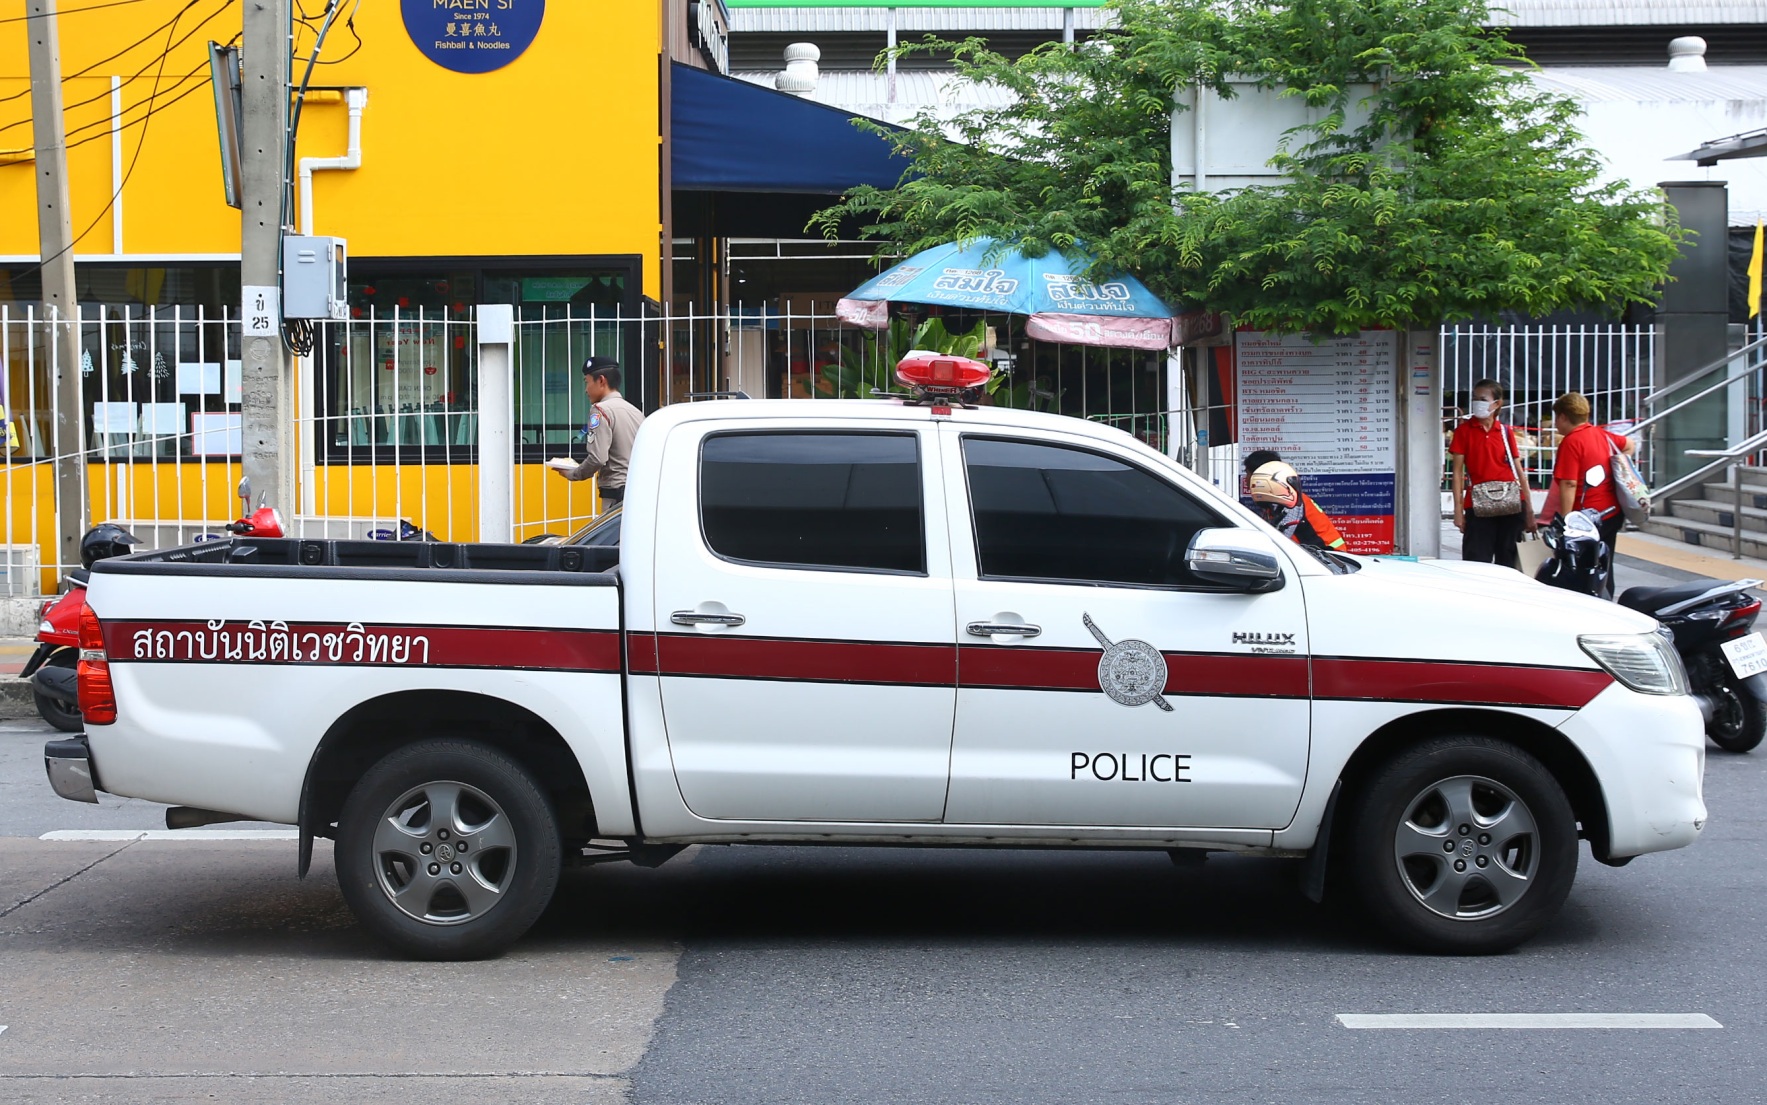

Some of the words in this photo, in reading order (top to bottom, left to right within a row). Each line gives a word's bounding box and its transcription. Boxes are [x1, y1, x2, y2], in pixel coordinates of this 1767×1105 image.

[433, 0, 489, 9] MAEN
[453, 12, 472, 20] Since
[473, 12, 490, 20] 1974
[444, 22, 501, 37] 曼喜魚丸
[435, 41, 466, 49] Fishball
[477, 41, 510, 49] Noodles
[934, 270, 1018, 294] สมใจ
[252, 316, 269, 330] 25
[1069, 321, 1102, 340] 50
[132, 618, 430, 664] สถาบันนิติเวชวิทยา
[1232, 631, 1296, 645] HILUX
[1071, 751, 1192, 783] POLICE
